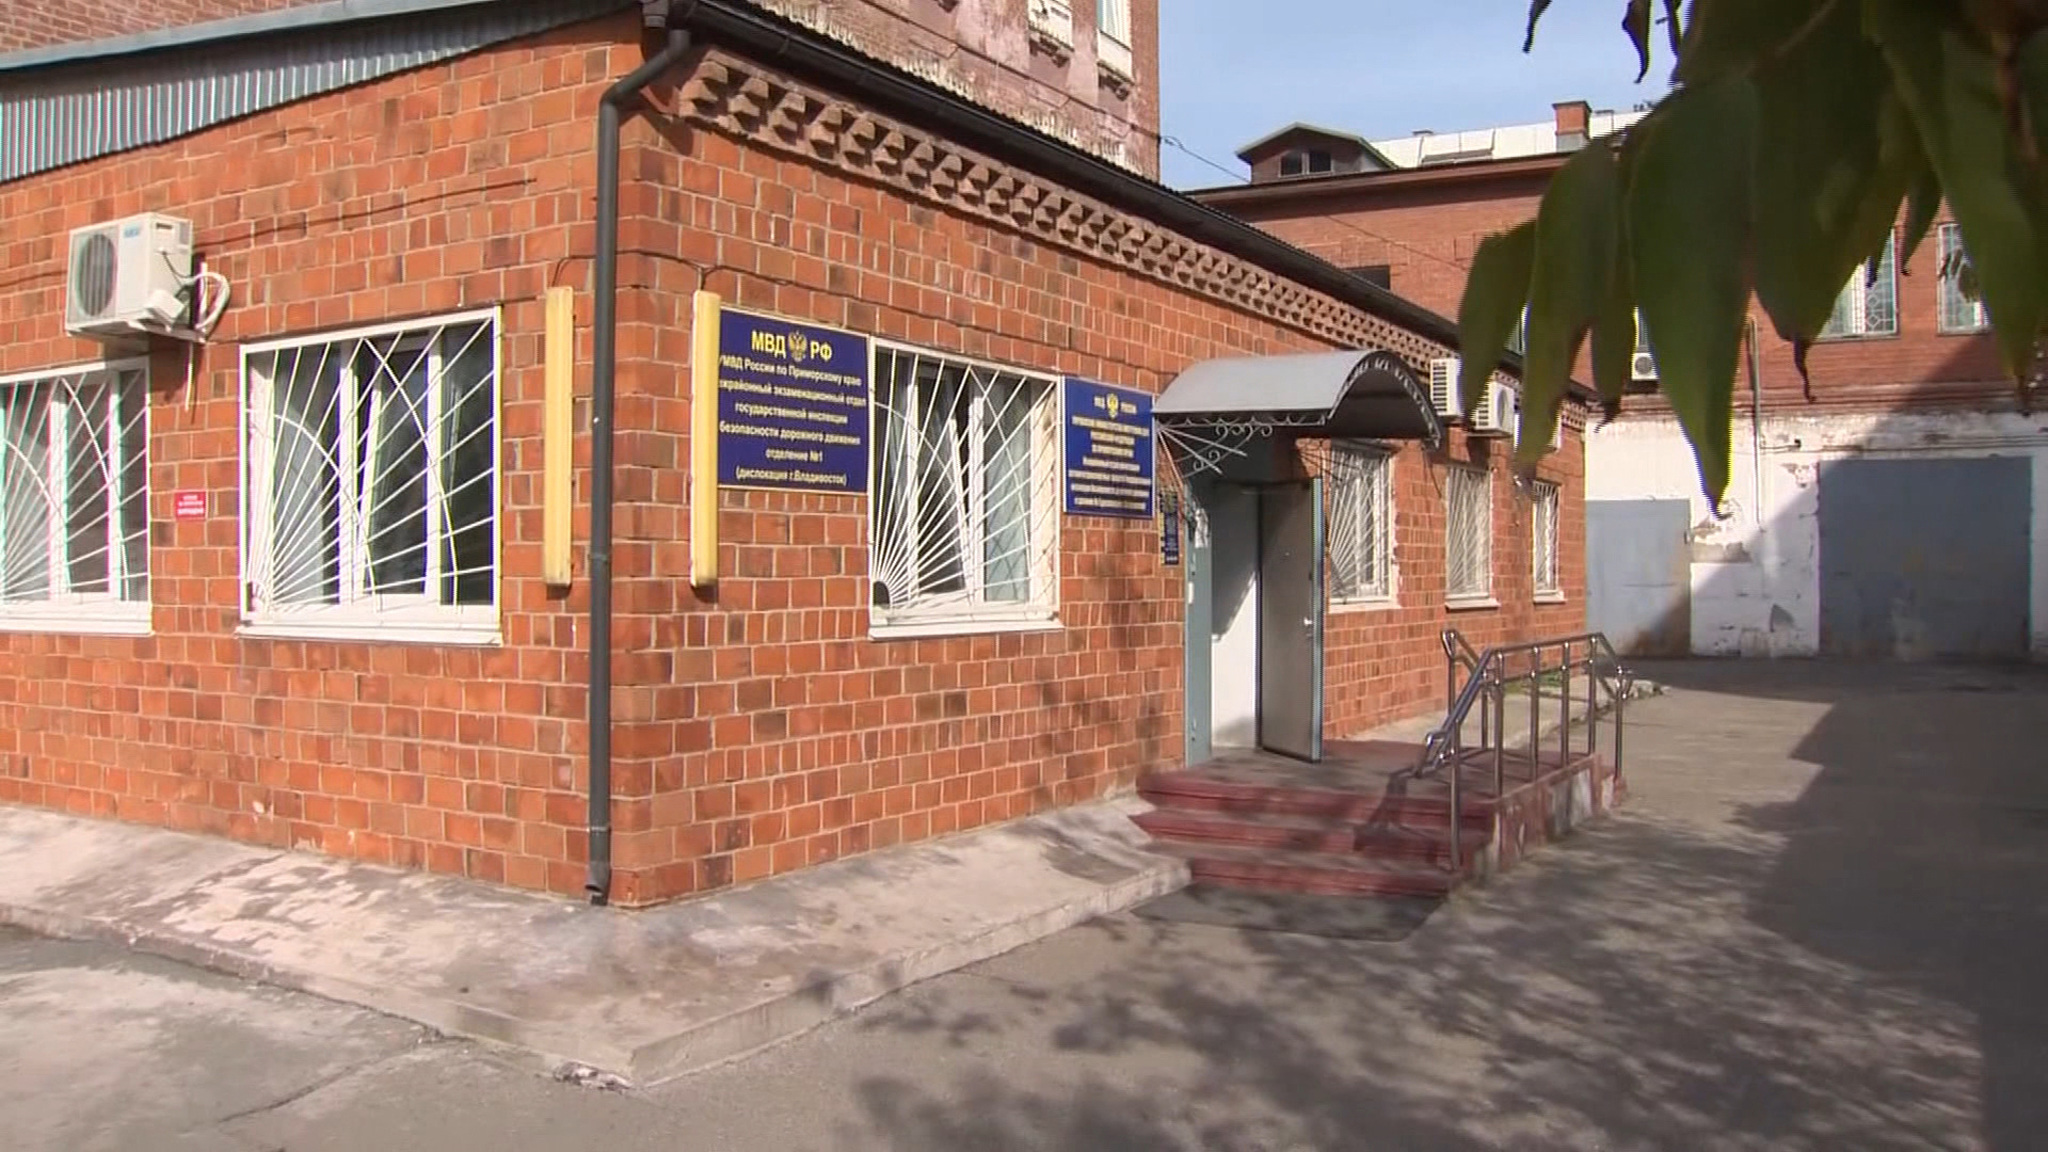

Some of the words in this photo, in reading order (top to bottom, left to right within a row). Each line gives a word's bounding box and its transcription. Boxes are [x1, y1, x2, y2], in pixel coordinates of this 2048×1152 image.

[751, 331, 787, 359] МВД
[810, 341, 832, 362] РФ
[744, 358, 775, 375] России
[776, 365, 787, 376] по
[788, 365, 843, 386] Приморскому
[735, 402, 806, 419] государственной
[719, 420, 780, 437] безопасности
